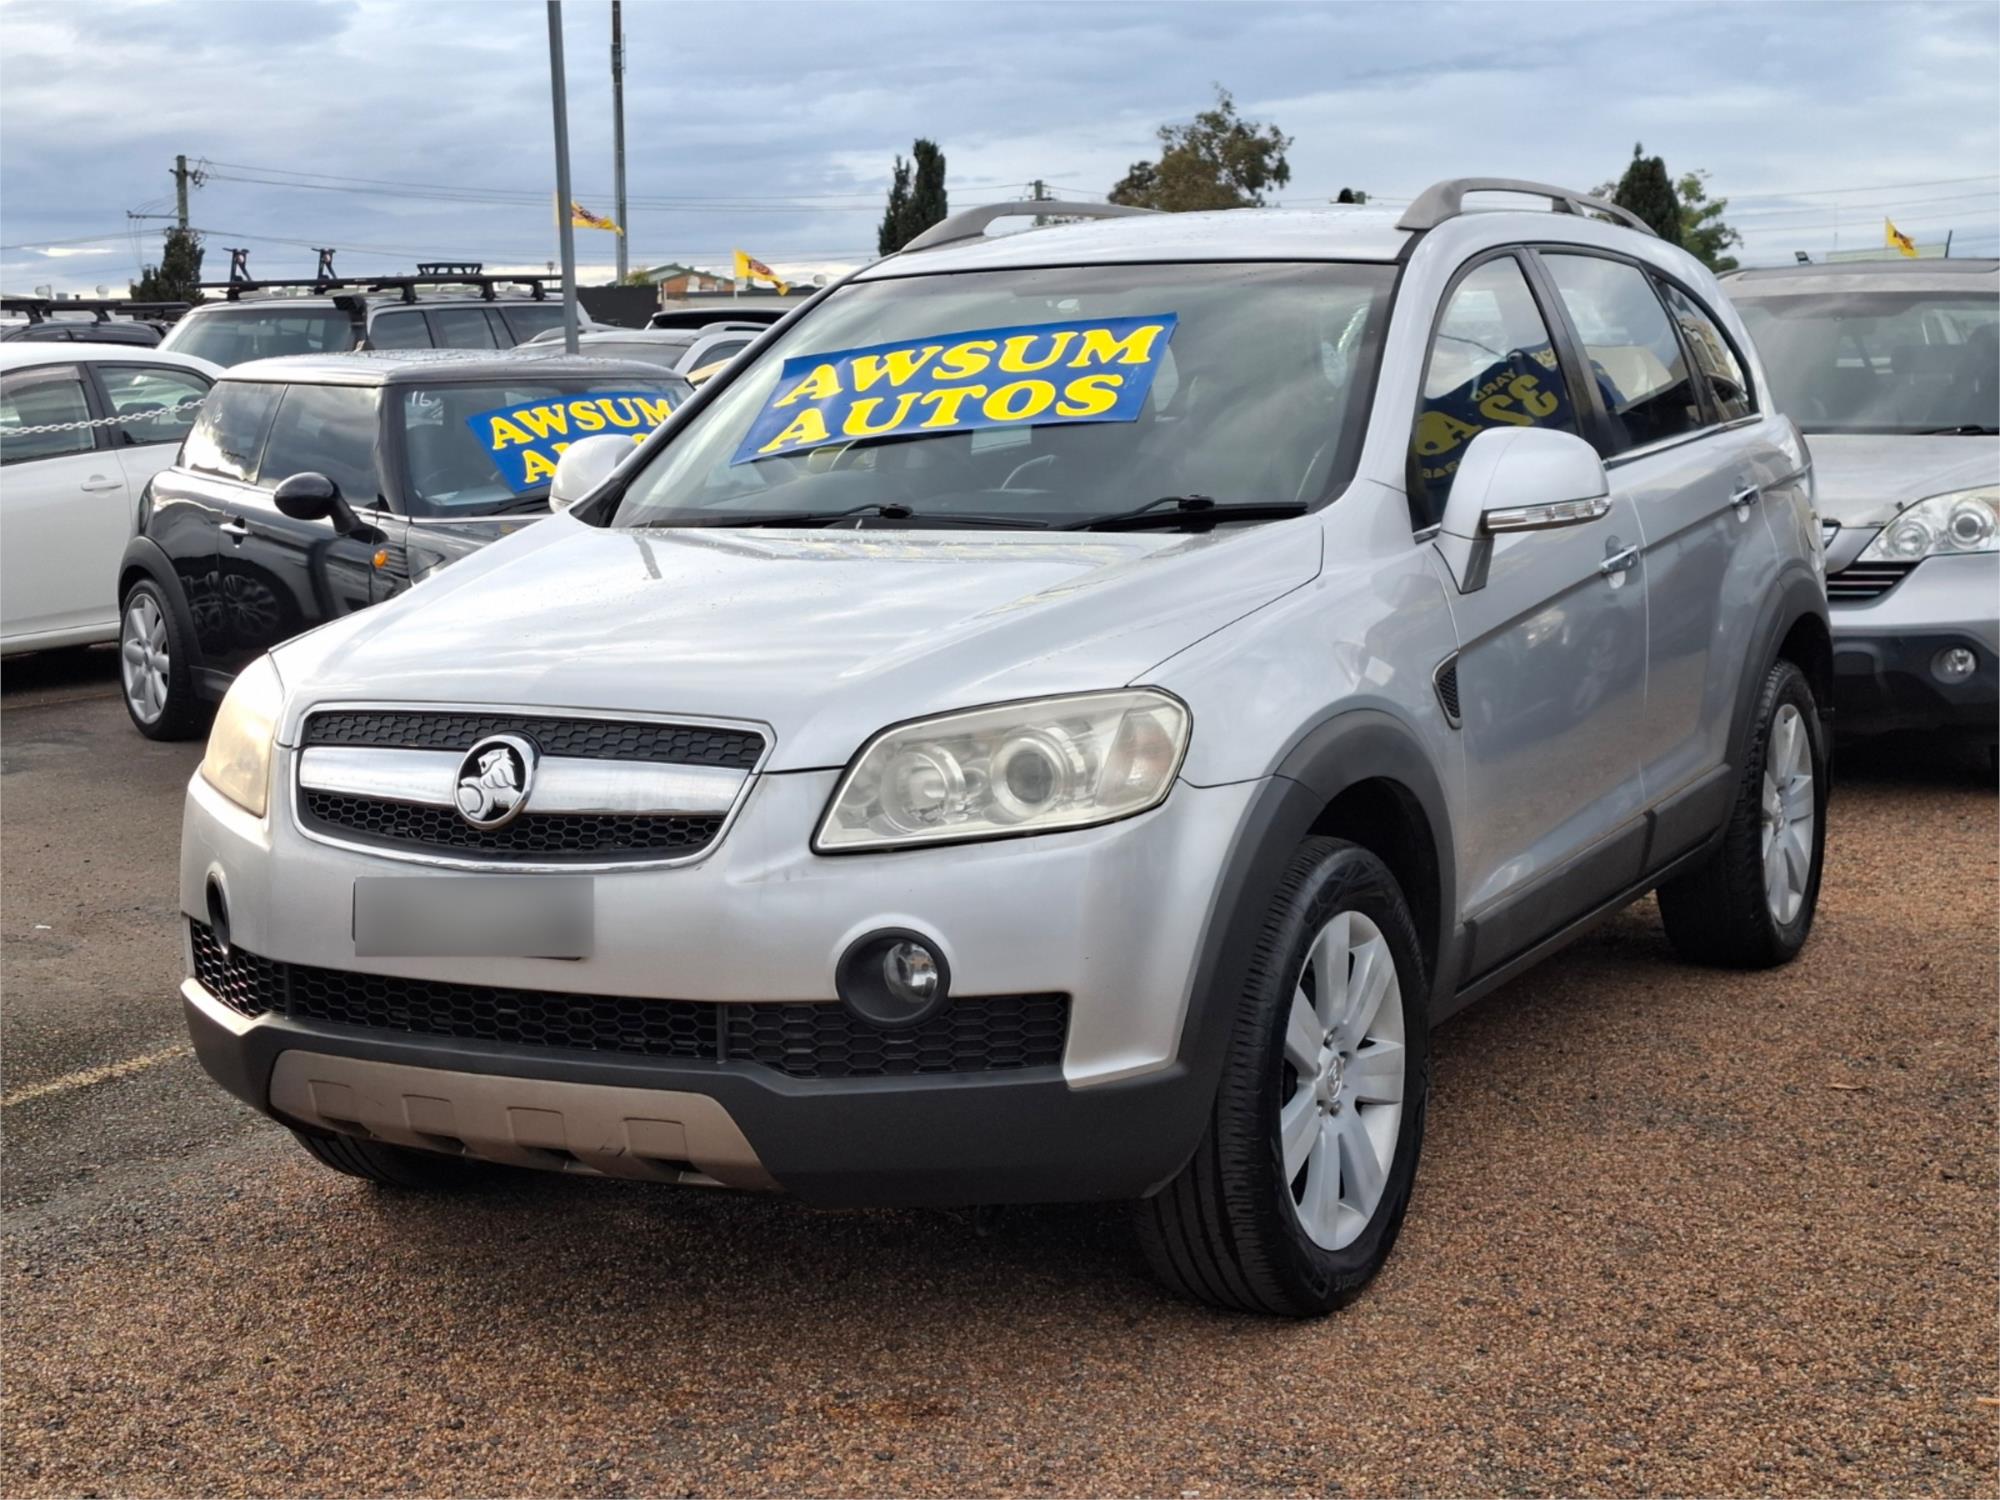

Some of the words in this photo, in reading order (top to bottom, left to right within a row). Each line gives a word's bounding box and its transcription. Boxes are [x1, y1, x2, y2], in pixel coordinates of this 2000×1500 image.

[411, 390, 433, 407] 16
[773, 324, 1165, 408] AWSUM
[490, 397, 676, 450] AWSUM
[758, 373, 1124, 454] AUTOS
